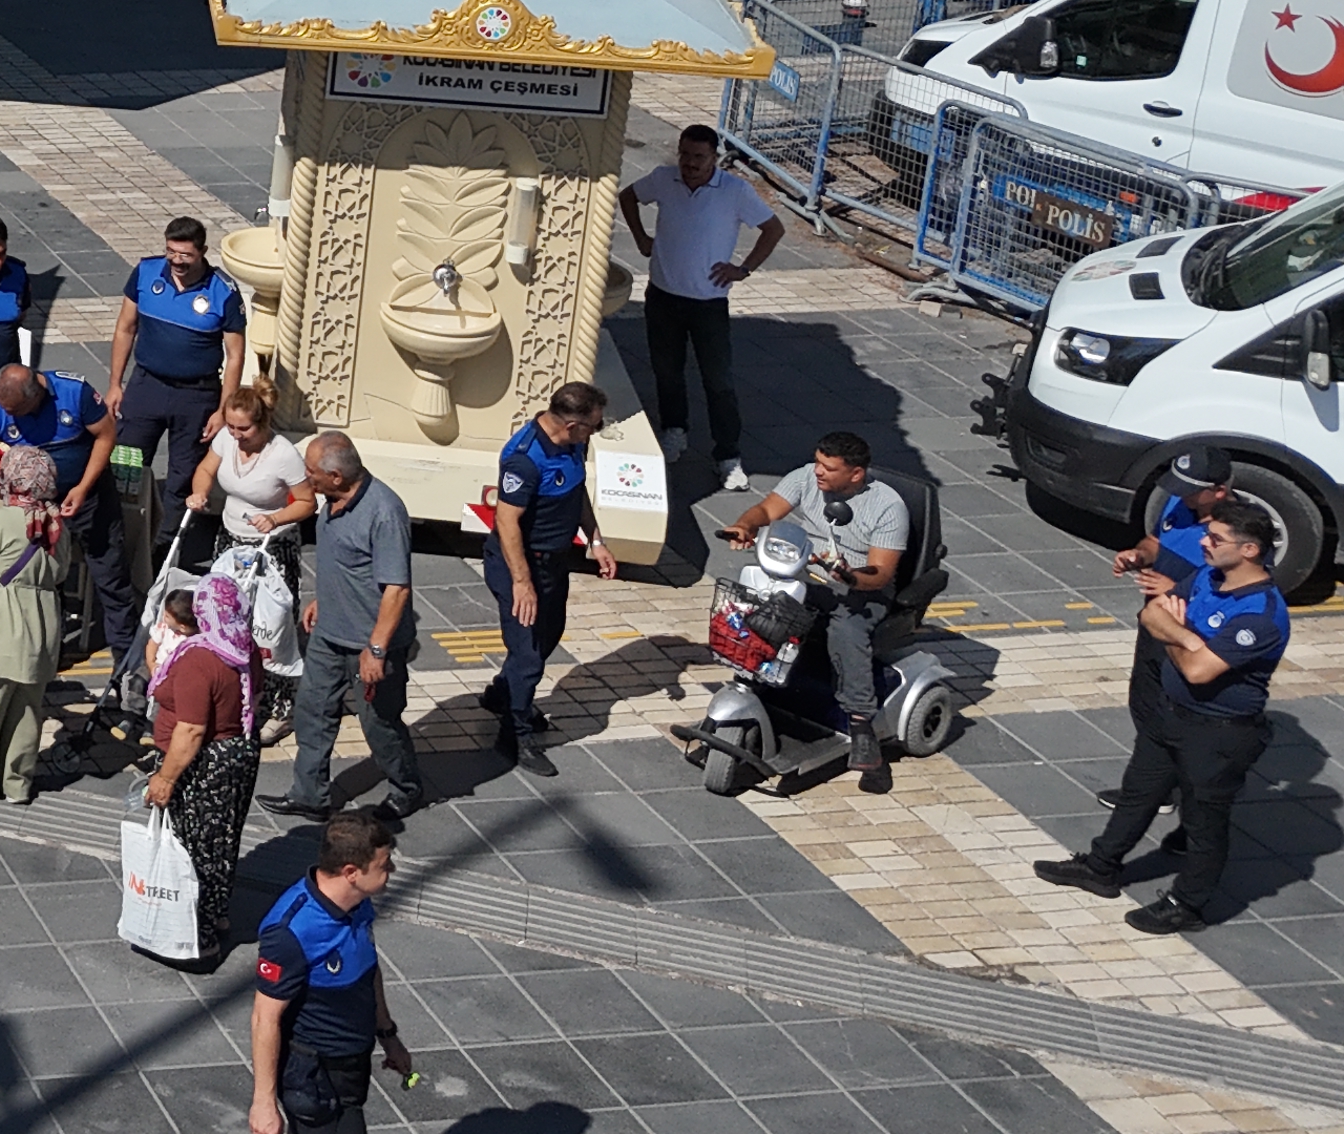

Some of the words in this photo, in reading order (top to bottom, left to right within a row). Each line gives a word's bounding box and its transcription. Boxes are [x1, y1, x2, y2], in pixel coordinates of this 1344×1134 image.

[418, 72, 483, 90] İKRAM
[489, 79, 578, 97] ÇEŞMESİ
[1046, 204, 1105, 243] POLİS
